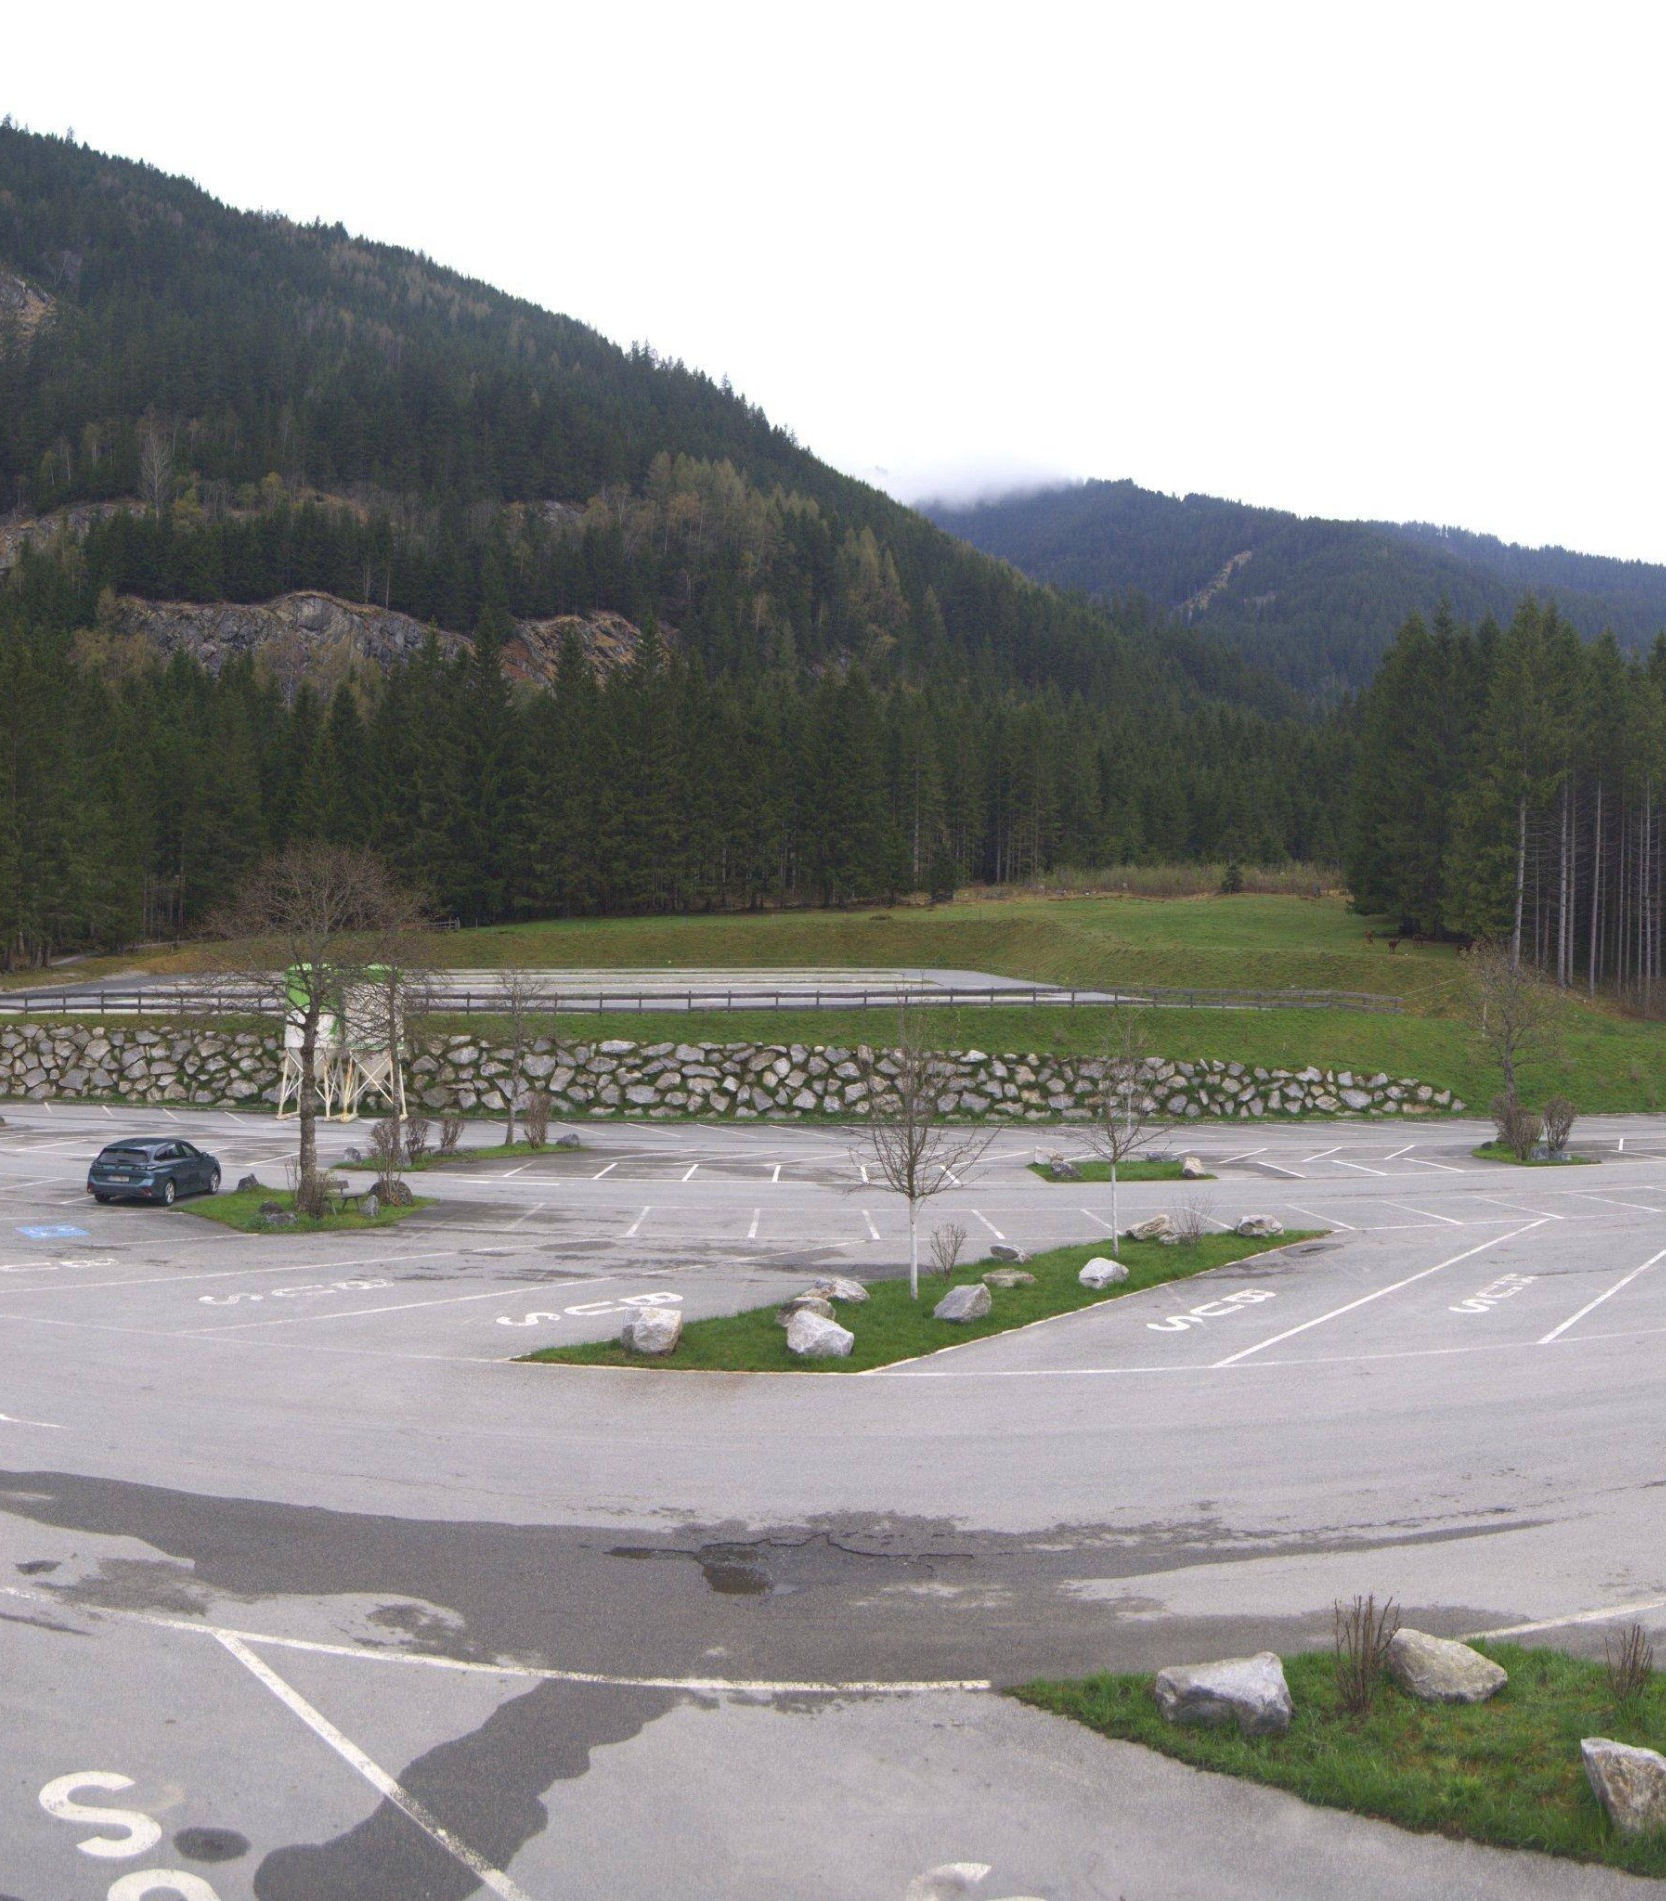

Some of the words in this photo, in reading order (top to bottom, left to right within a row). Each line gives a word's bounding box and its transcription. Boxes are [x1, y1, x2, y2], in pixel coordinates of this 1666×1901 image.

[198, 1277, 394, 1305] BUS
[496, 1291, 683, 1326] BUS
[1147, 1288, 1277, 1331] BUS
